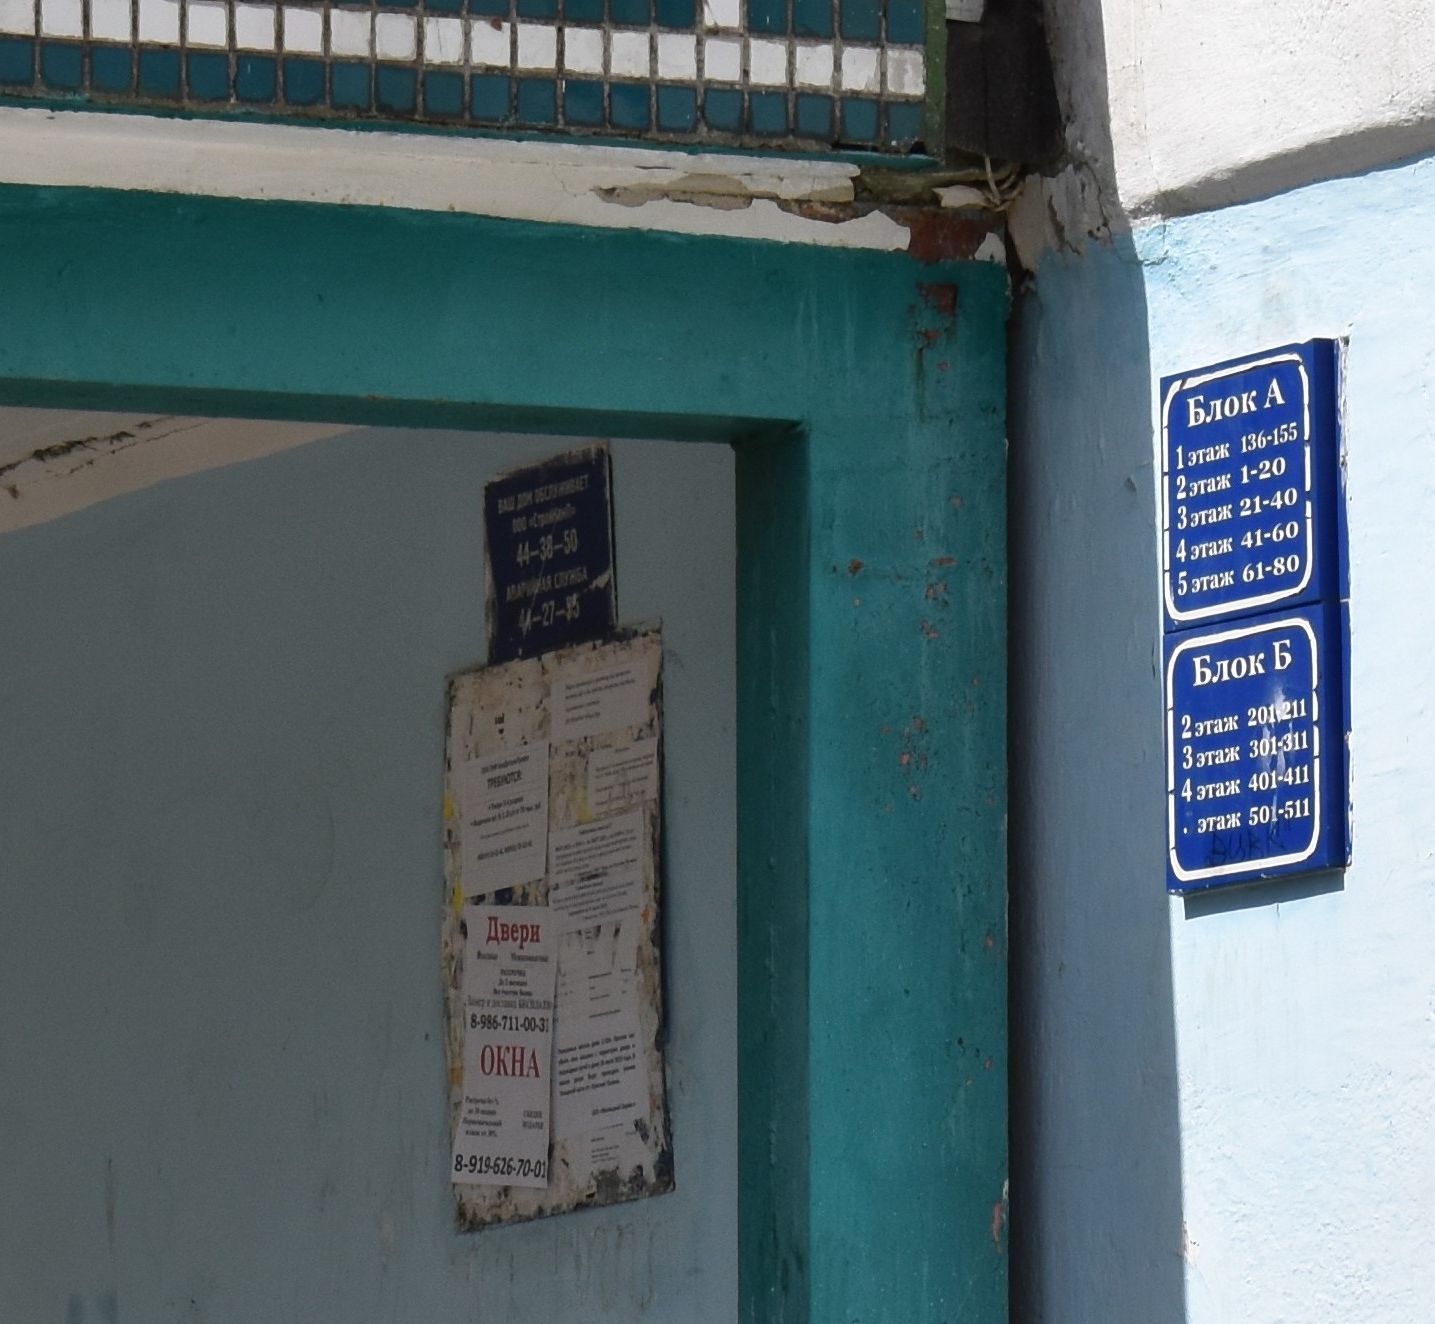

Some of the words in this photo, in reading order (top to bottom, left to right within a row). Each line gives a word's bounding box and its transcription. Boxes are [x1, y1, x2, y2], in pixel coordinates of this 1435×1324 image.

[1187, 390, 1257, 427] Блок
[1264, 378, 1285, 408] А
[1176, 445, 1184, 470] 1
[1188, 443, 1230, 467] этаж
[1241, 422, 1298, 453] 136-155
[1176, 475, 1187, 500] 2
[1189, 473, 1231, 497] этаж
[1241, 457, 1286, 484] 1-20
[1177, 505, 1187, 530] 3
[1191, 503, 1232, 528] этаж
[1240, 488, 1298, 516] 21-40
[1176, 539, 1186, 563] 4
[1191, 536, 1233, 561] этаж
[1241, 521, 1299, 548] 41-60
[1177, 571, 1188, 595] 5
[1192, 569, 1234, 594] этаж
[1242, 554, 1300, 583] 61-80
[1193, 651, 1265, 686] Блок
[1273, 639, 1292, 671] Б
[1181, 714, 1192, 739] 2
[1195, 715, 1239, 737] этаж
[1182, 745, 1193, 770] 3
[1196, 746, 1240, 768] этаж
[1249, 730, 1308, 758] 301-311
[1181, 778, 1192, 802] 4
[1196, 779, 1241, 801] этаж
[1248, 764, 1309, 792] 401-411
[1197, 812, 1241, 834] этаж
[1249, 797, 1310, 826] 501-511
[486, 916, 541, 949] Двери
[481, 1044, 541, 1079] ОКНА
[454, 1153, 547, 1179] 8-919-626-70-01
